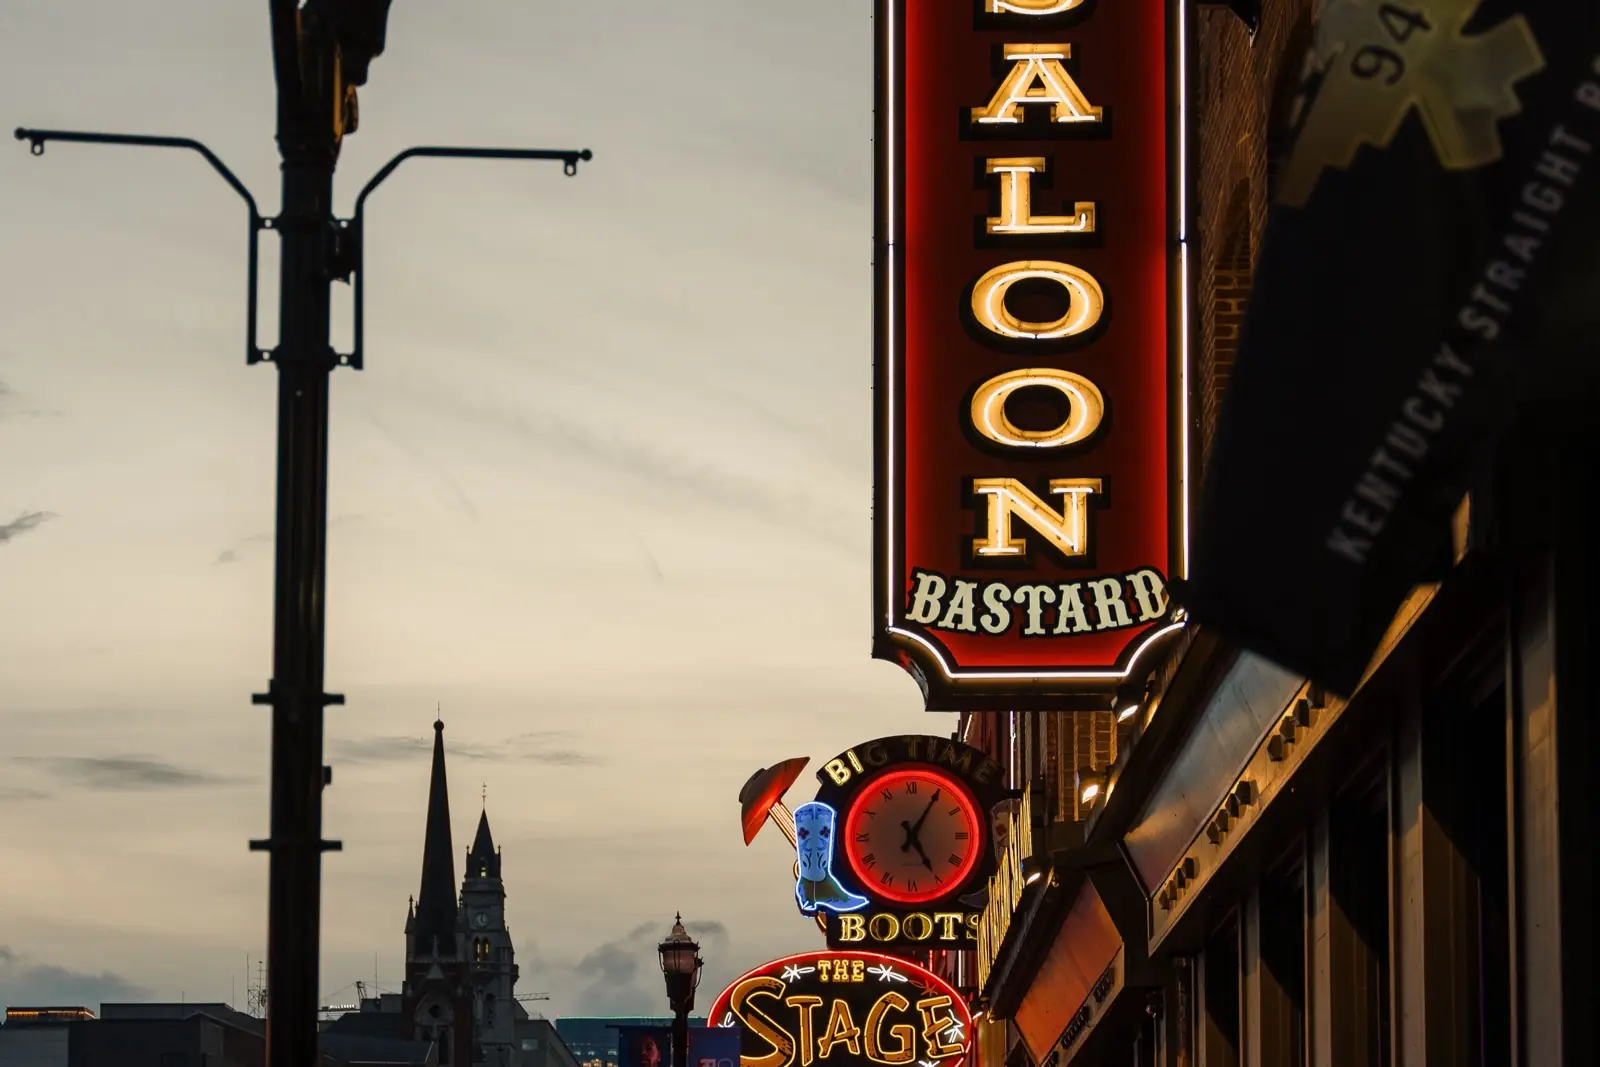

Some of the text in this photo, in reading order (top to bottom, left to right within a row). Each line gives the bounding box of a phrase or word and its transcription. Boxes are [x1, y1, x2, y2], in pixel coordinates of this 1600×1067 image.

[1352, 4, 1430, 86] 94
[970, 0, 1105, 557] ALOON
[1325, 123, 1593, 565] KENTUCKY STRAIGHT
[904, 568, 1170, 636] BASTARD
[823, 735, 999, 788] BIG TIME
[817, 959, 865, 982] THE
[730, 976, 966, 1067] STAGE
